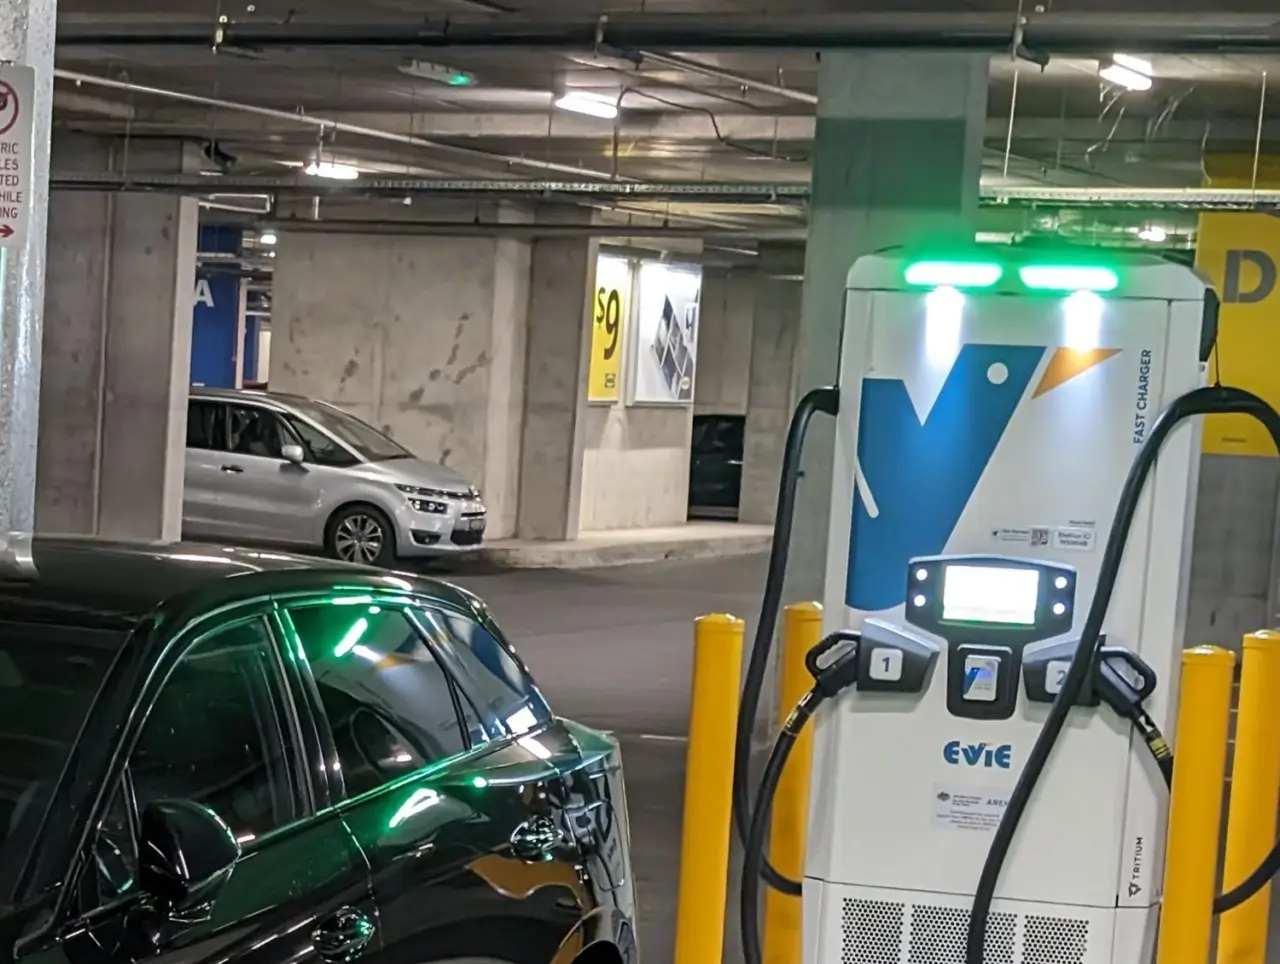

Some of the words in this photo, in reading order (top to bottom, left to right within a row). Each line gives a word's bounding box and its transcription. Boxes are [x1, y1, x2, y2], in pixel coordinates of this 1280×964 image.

[1222, 249, 1277, 304] D
[1136, 349, 1152, 411] CHARGER
[1133, 413, 1146, 444] FAST
[882, 656, 891, 673] 1
[1056, 669, 1067, 686] 2
[1132, 836, 1144, 880] TRITIUM
